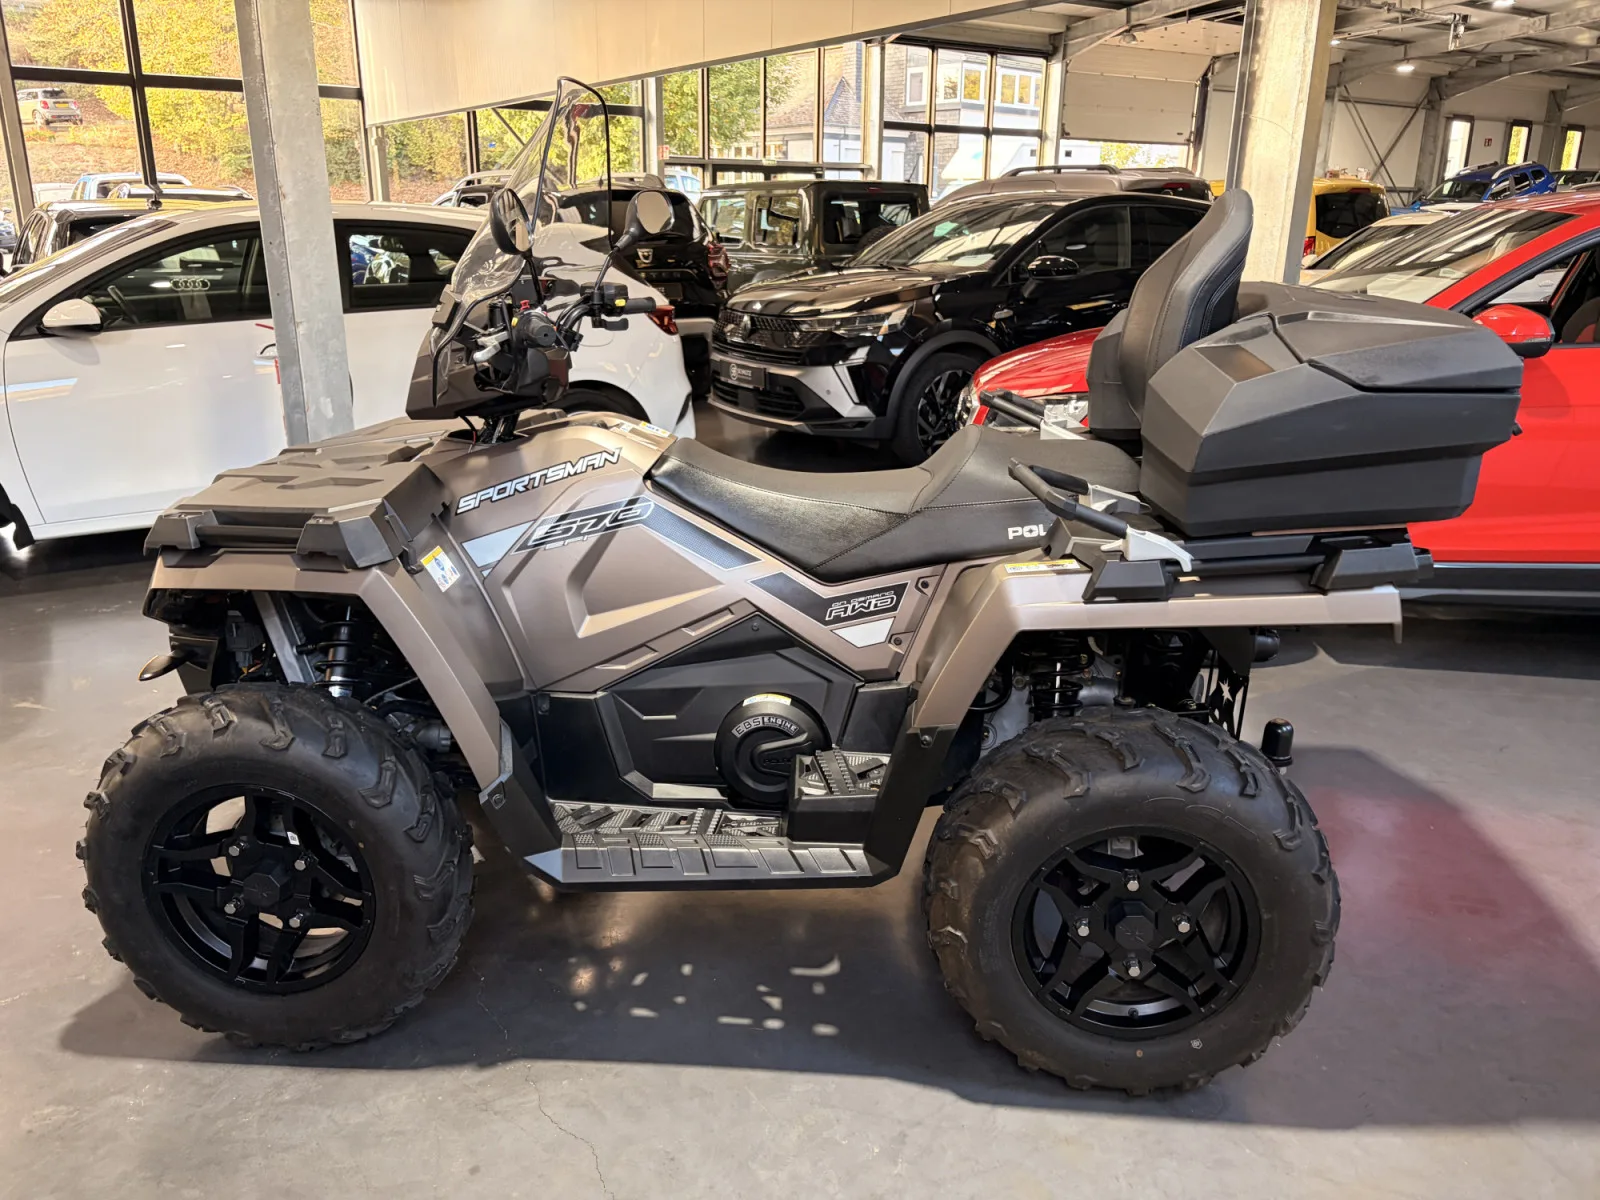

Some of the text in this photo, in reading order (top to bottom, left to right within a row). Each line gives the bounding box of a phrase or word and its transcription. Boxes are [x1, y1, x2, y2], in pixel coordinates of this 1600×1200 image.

[456, 447, 622, 515] SPORTSMAN
[1007, 523, 1053, 540] POL
[825, 594, 897, 620] AWD
[735, 717, 761, 735] EBS
[763, 717, 797, 732] ENGINE
